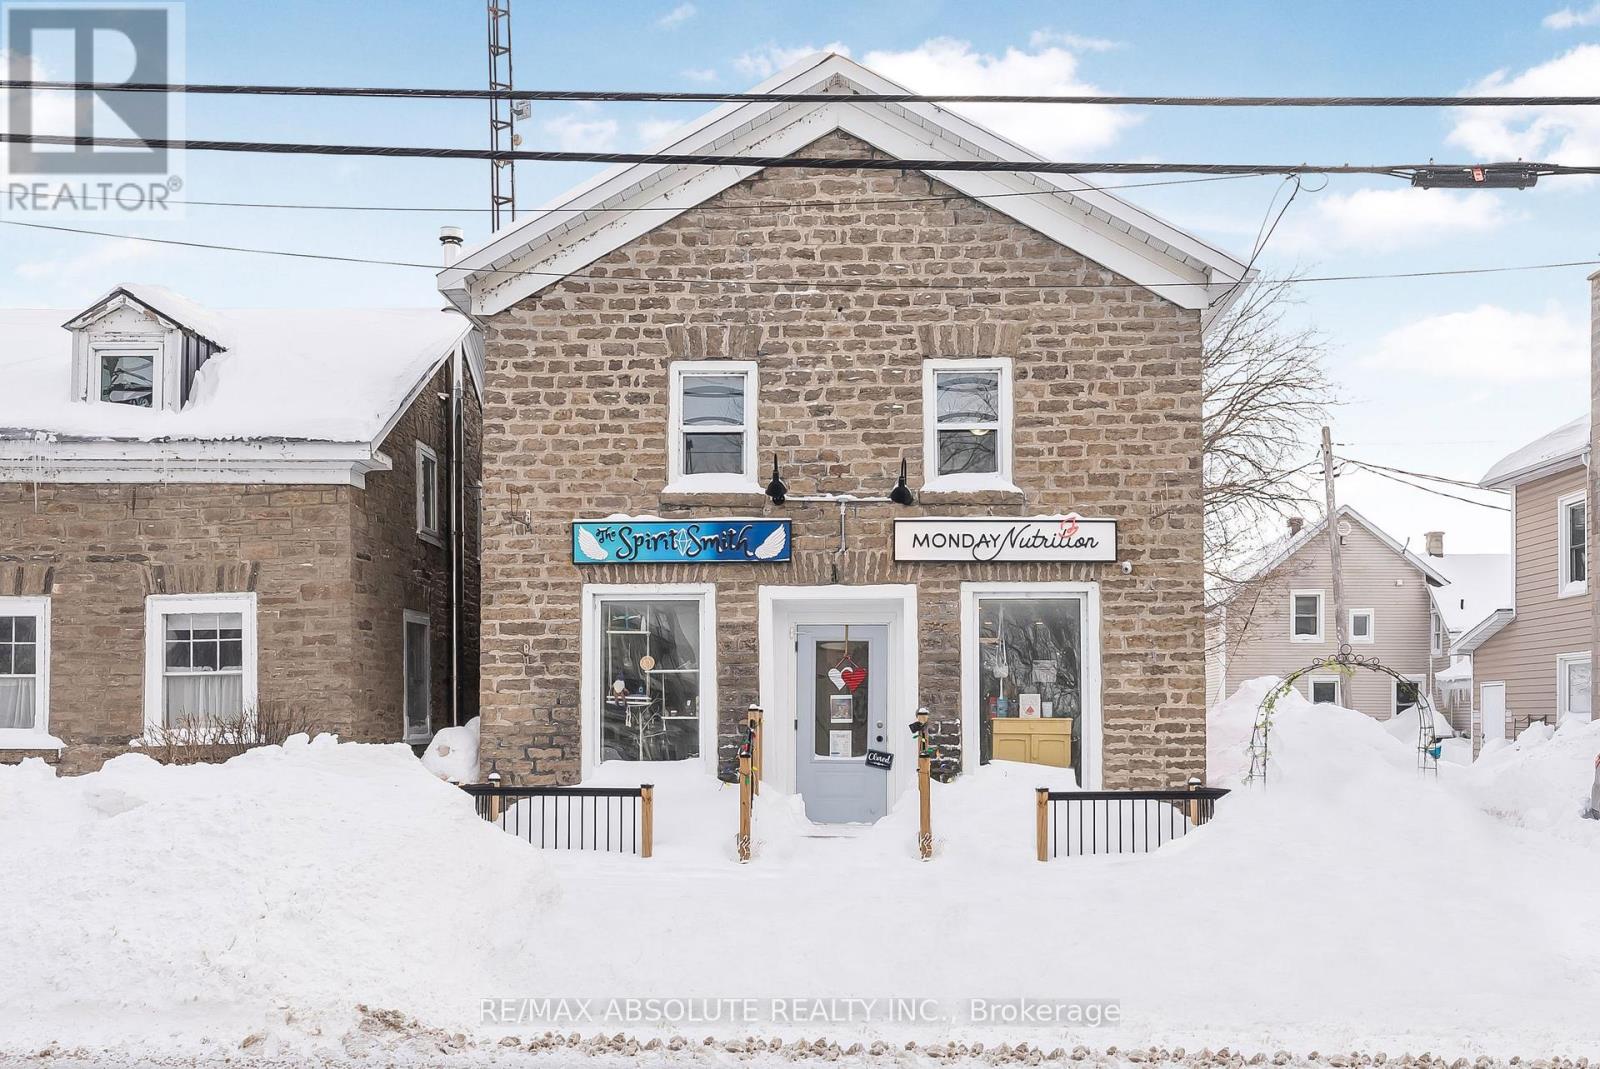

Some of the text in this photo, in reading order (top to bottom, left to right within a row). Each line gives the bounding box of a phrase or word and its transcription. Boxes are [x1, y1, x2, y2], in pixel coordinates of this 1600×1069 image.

[596, 525, 753, 560] The Spirit Smith
[912, 524, 1099, 561] MONDAY Nutrition
